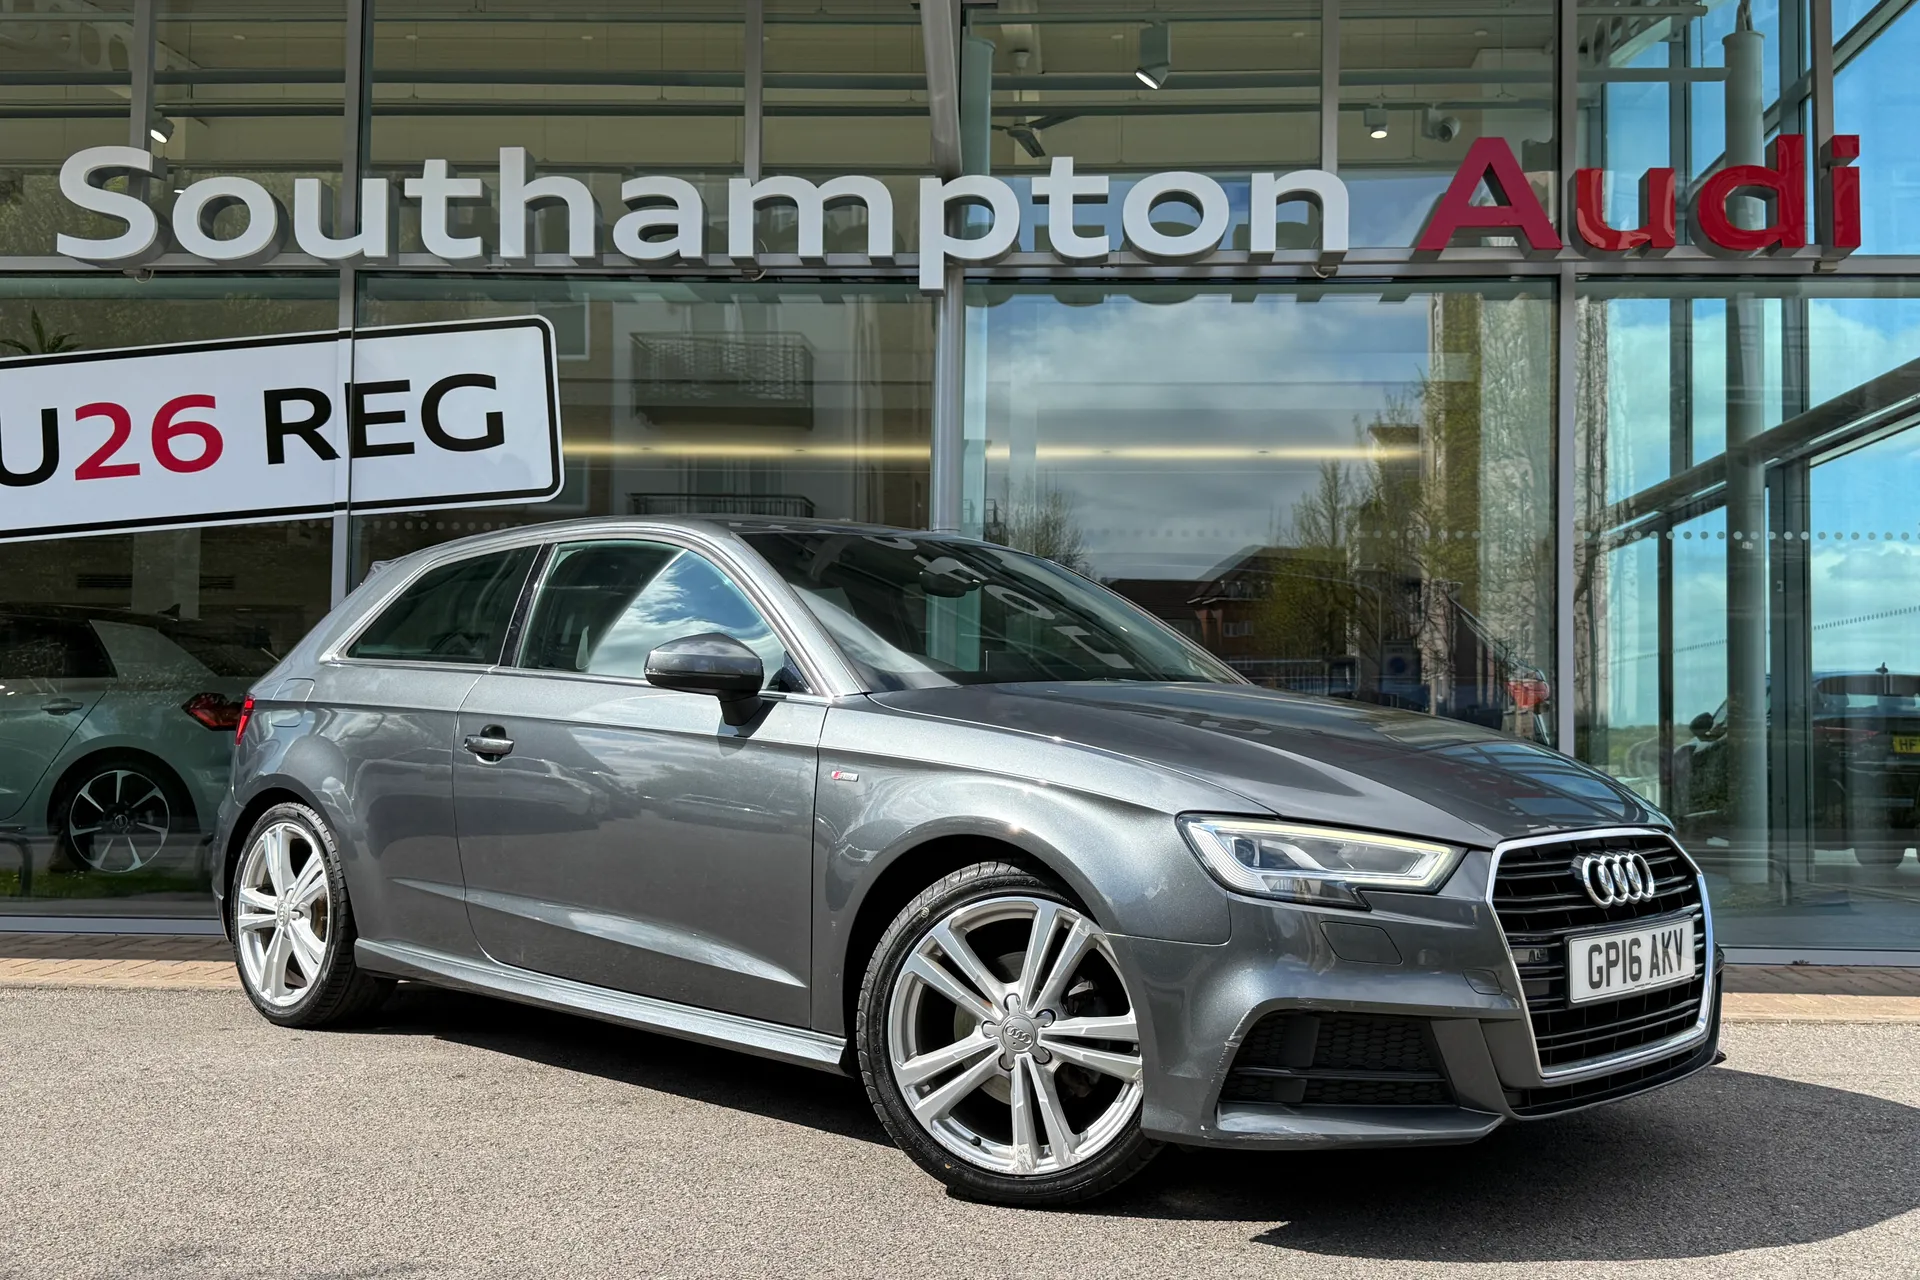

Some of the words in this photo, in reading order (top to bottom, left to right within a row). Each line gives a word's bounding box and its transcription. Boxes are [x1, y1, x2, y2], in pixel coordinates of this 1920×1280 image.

[56, 146, 1349, 290] Southampton
[1414, 134, 1861, 254] Audi
[263, 373, 504, 465] REG
[1588, 938, 1642, 989] GP16
[1649, 929, 1683, 978] AKV
